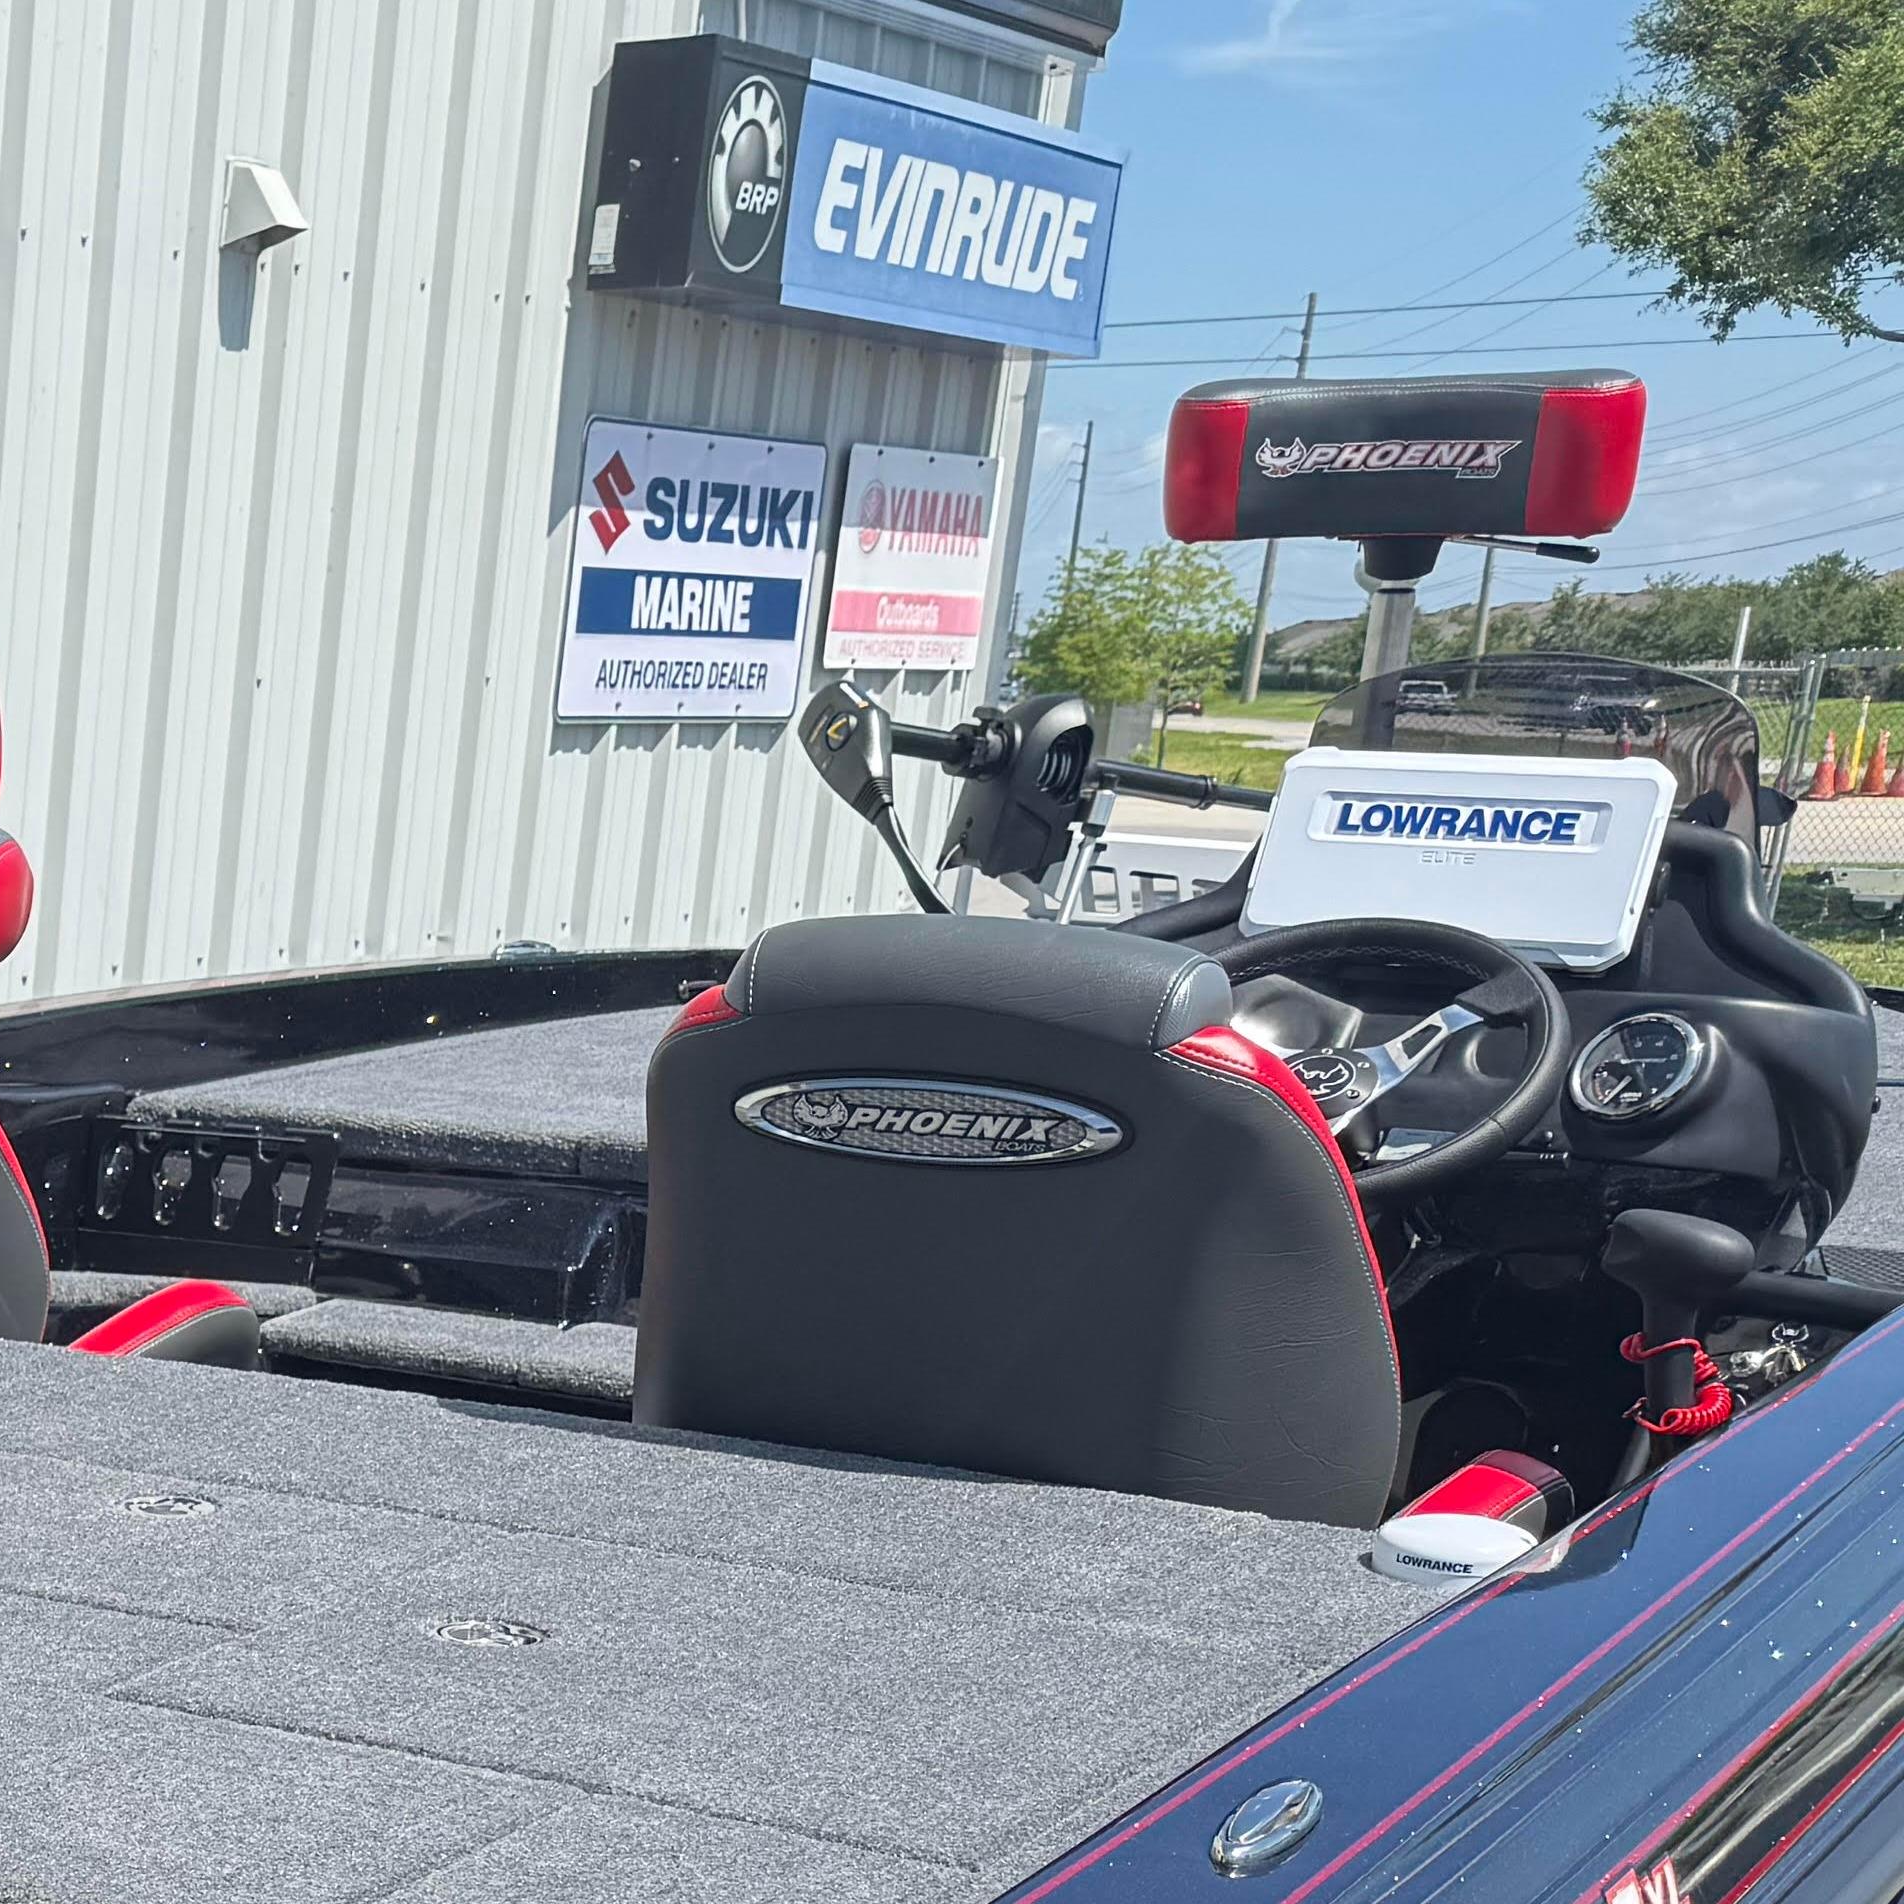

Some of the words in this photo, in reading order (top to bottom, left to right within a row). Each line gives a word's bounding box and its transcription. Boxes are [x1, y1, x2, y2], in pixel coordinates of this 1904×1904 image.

[735, 181, 778, 216] BRP
[814, 138, 1097, 300] EVINRUDE
[1298, 441, 1514, 470] PHOENIX
[644, 476, 814, 550] SUZUKI
[887, 487, 983, 558] YAMAHA
[631, 575, 754, 632] MARINE
[876, 595, 940, 630] Outboards
[840, 636, 913, 659] AUTHORIZED
[916, 639, 965, 660] SERVICE
[596, 660, 703, 691] AUTHORIZED
[707, 661, 769, 692] DEALER
[1337, 802, 1582, 844] LOWRANCE
[1420, 850, 1477, 866] ELITE
[846, 1108, 1059, 1142] PHOENIX
[995, 1141, 1047, 1153] BOATS
[1396, 1553, 1473, 1574] LOWRANCE
